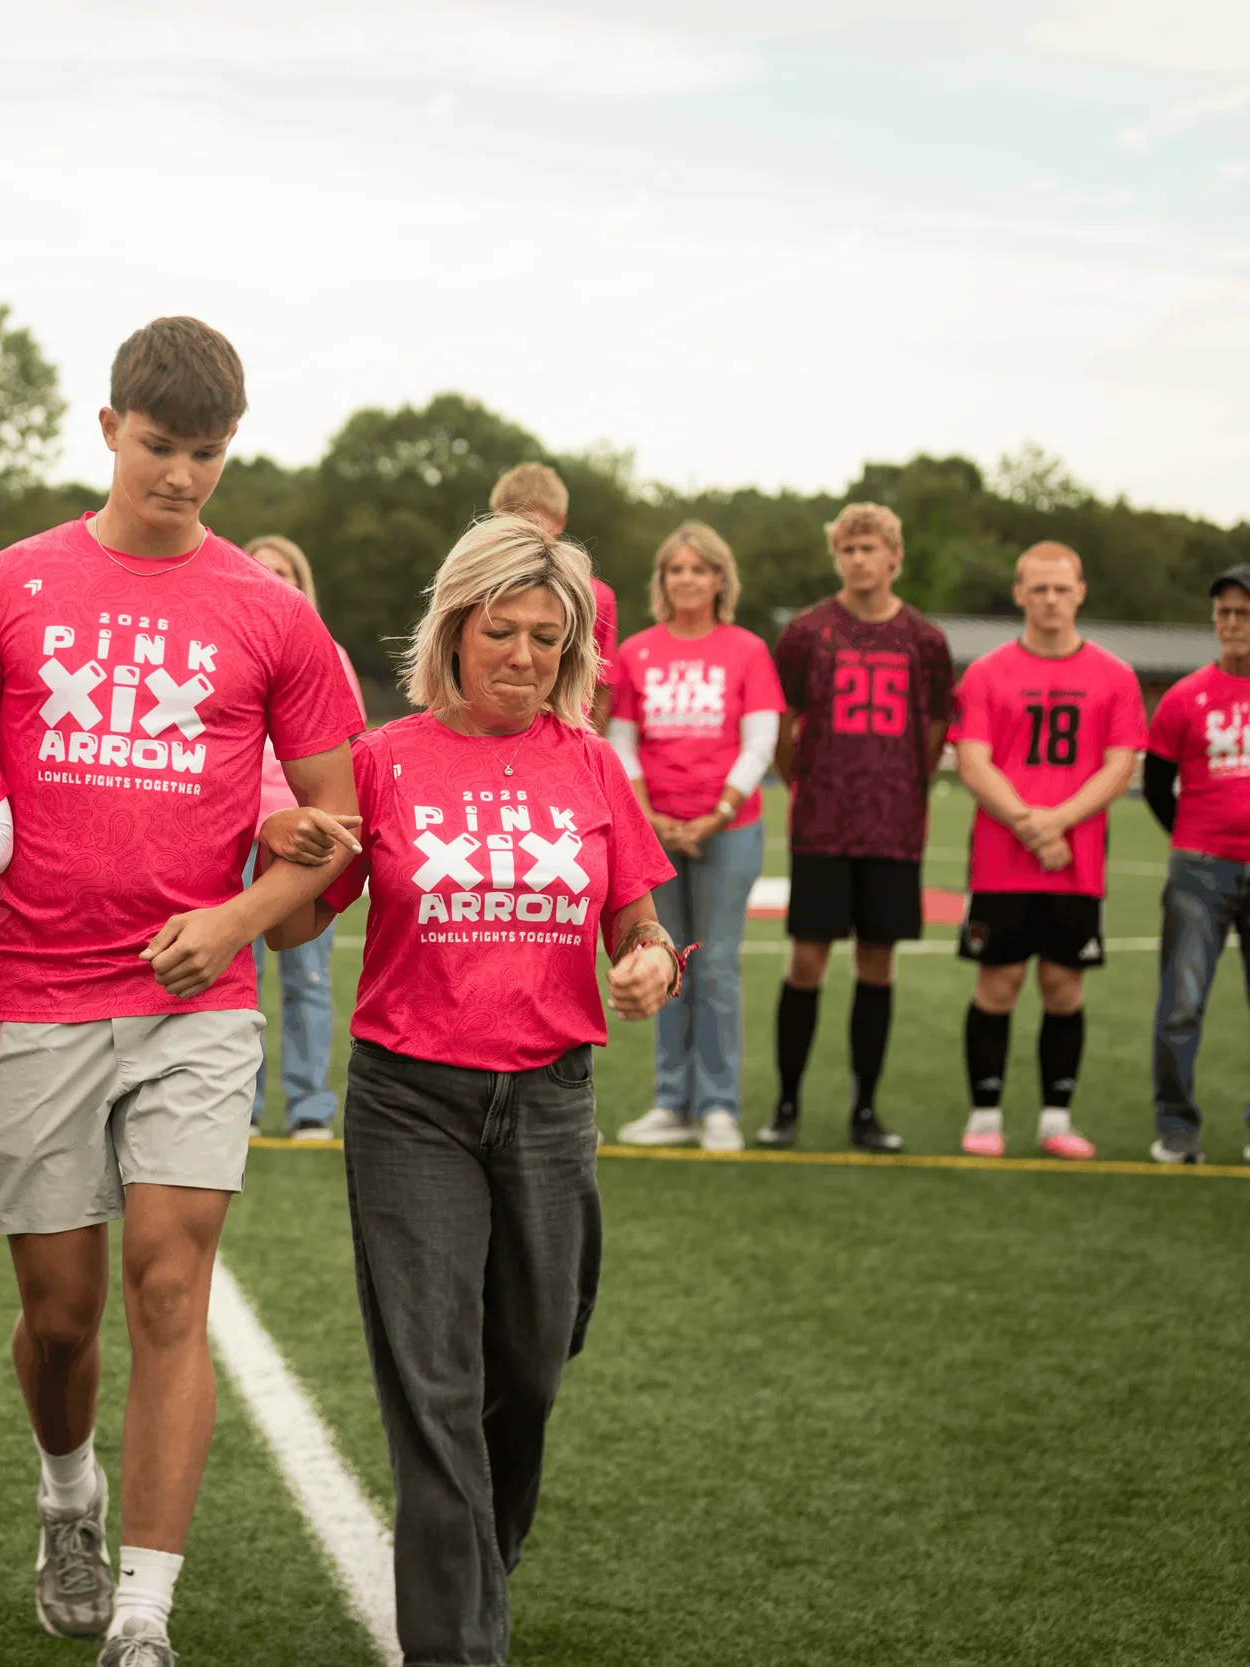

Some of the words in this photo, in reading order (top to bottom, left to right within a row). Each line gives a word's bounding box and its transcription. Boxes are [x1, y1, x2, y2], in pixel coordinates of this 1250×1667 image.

[99, 612, 169, 630] 2026
[832, 665, 910, 737] 25
[1025, 704, 1080, 766] 18
[37, 730, 207, 774] ARROW
[37, 770, 82, 785] LOWELL
[134, 778, 202, 796] TOGETHER
[462, 790, 527, 802] 2026
[417, 892, 591, 926] ARROW
[420, 931, 469, 943] LOWELL
[519, 931, 582, 946] TOGETHER
